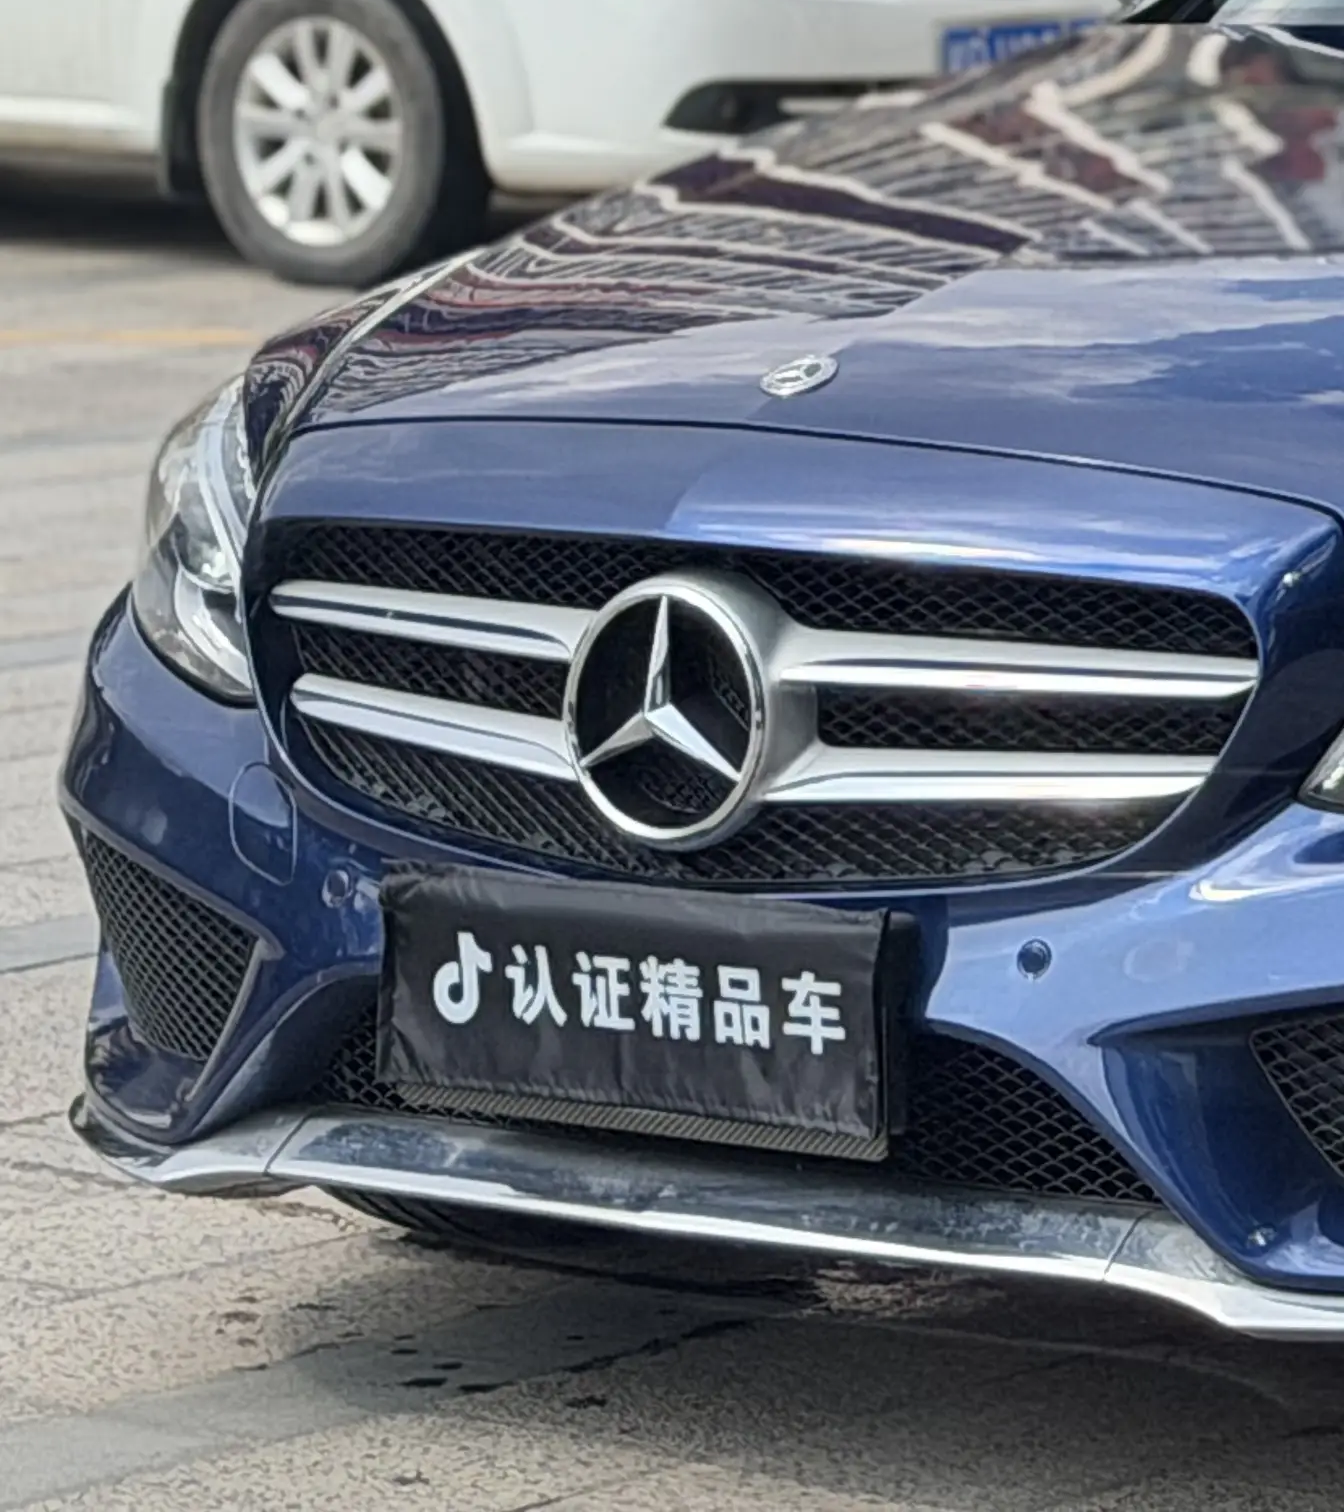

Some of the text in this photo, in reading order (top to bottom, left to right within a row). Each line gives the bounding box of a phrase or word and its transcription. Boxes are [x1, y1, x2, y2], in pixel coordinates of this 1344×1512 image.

[505, 944, 847, 1055] 认证精品车
